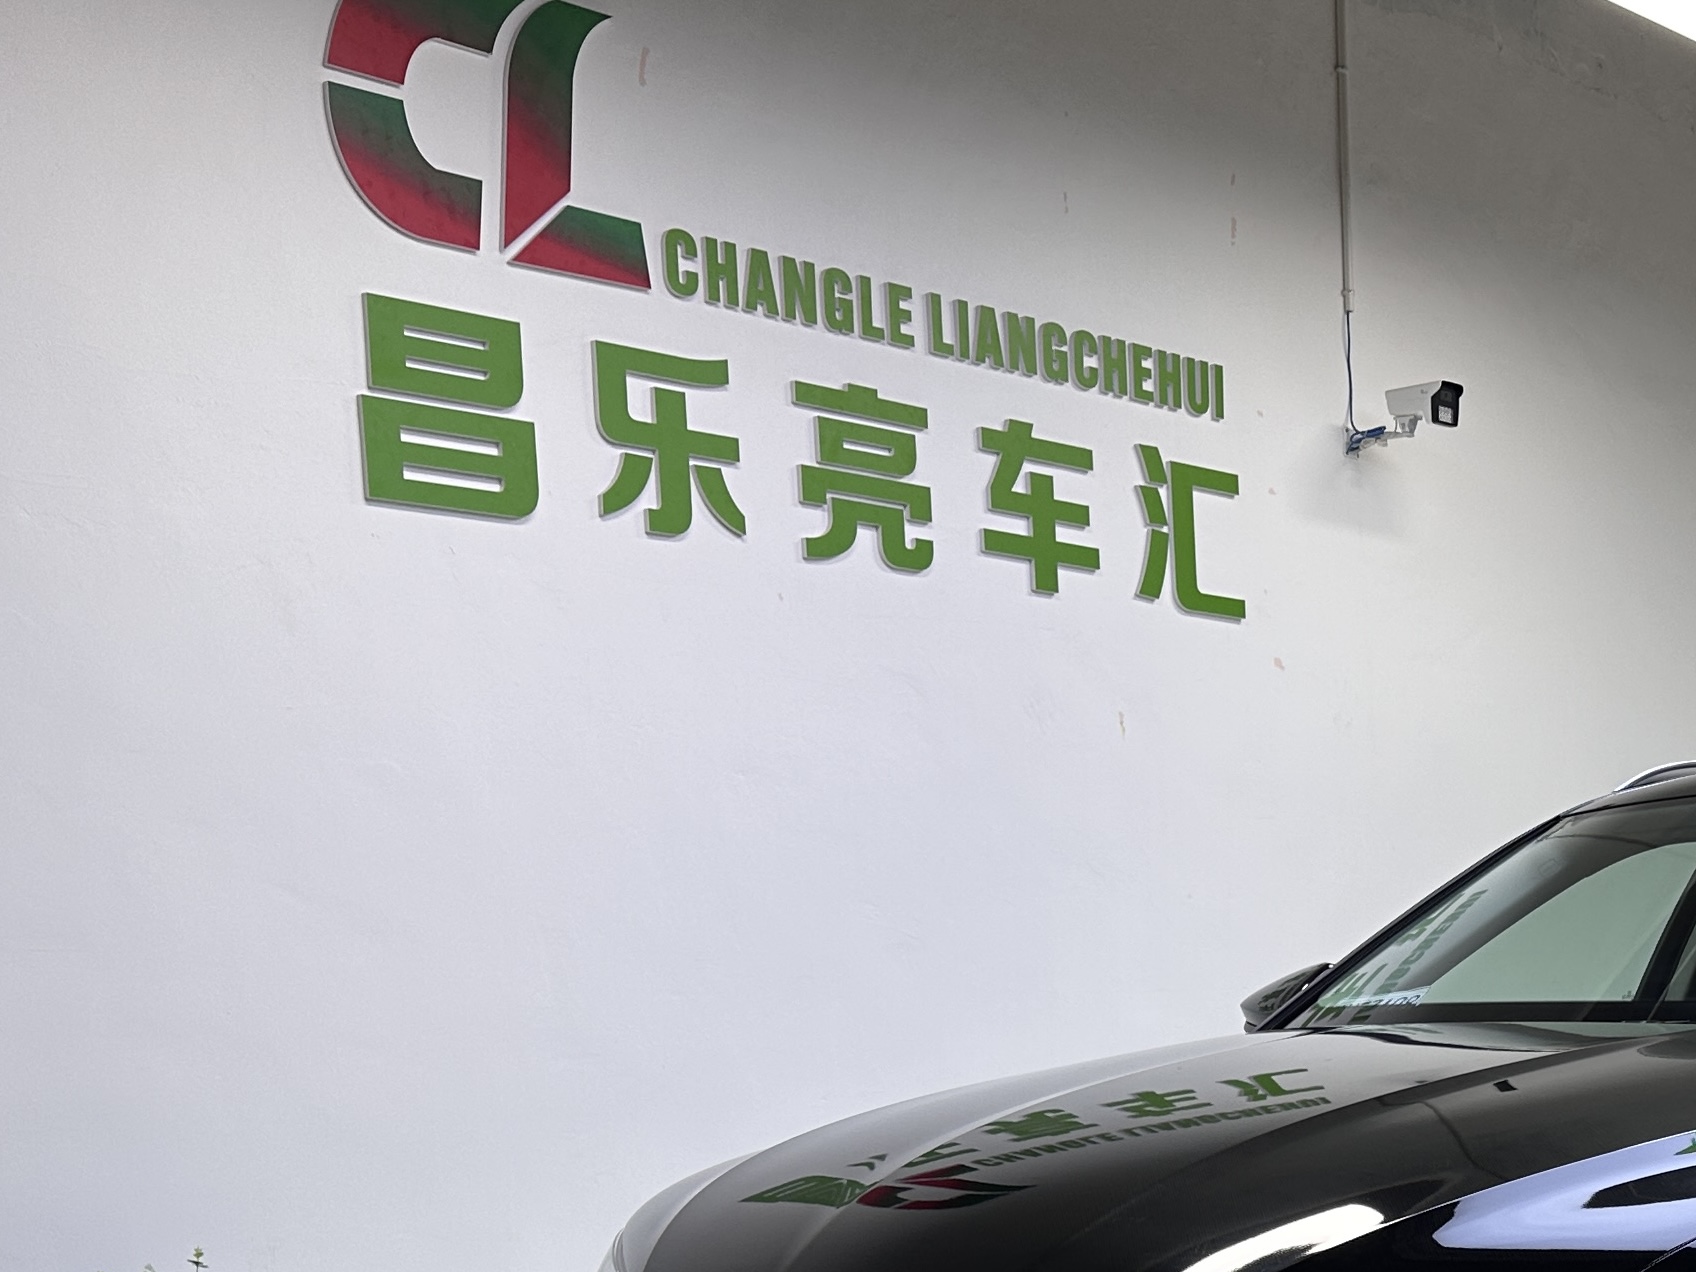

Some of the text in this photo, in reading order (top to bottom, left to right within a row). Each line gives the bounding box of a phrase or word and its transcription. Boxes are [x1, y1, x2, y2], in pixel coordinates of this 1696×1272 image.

[663, 228, 1226, 421] CHANGLE LIANGCHEHUI
[356, 292, 1248, 622] 昌乐亮车汇
